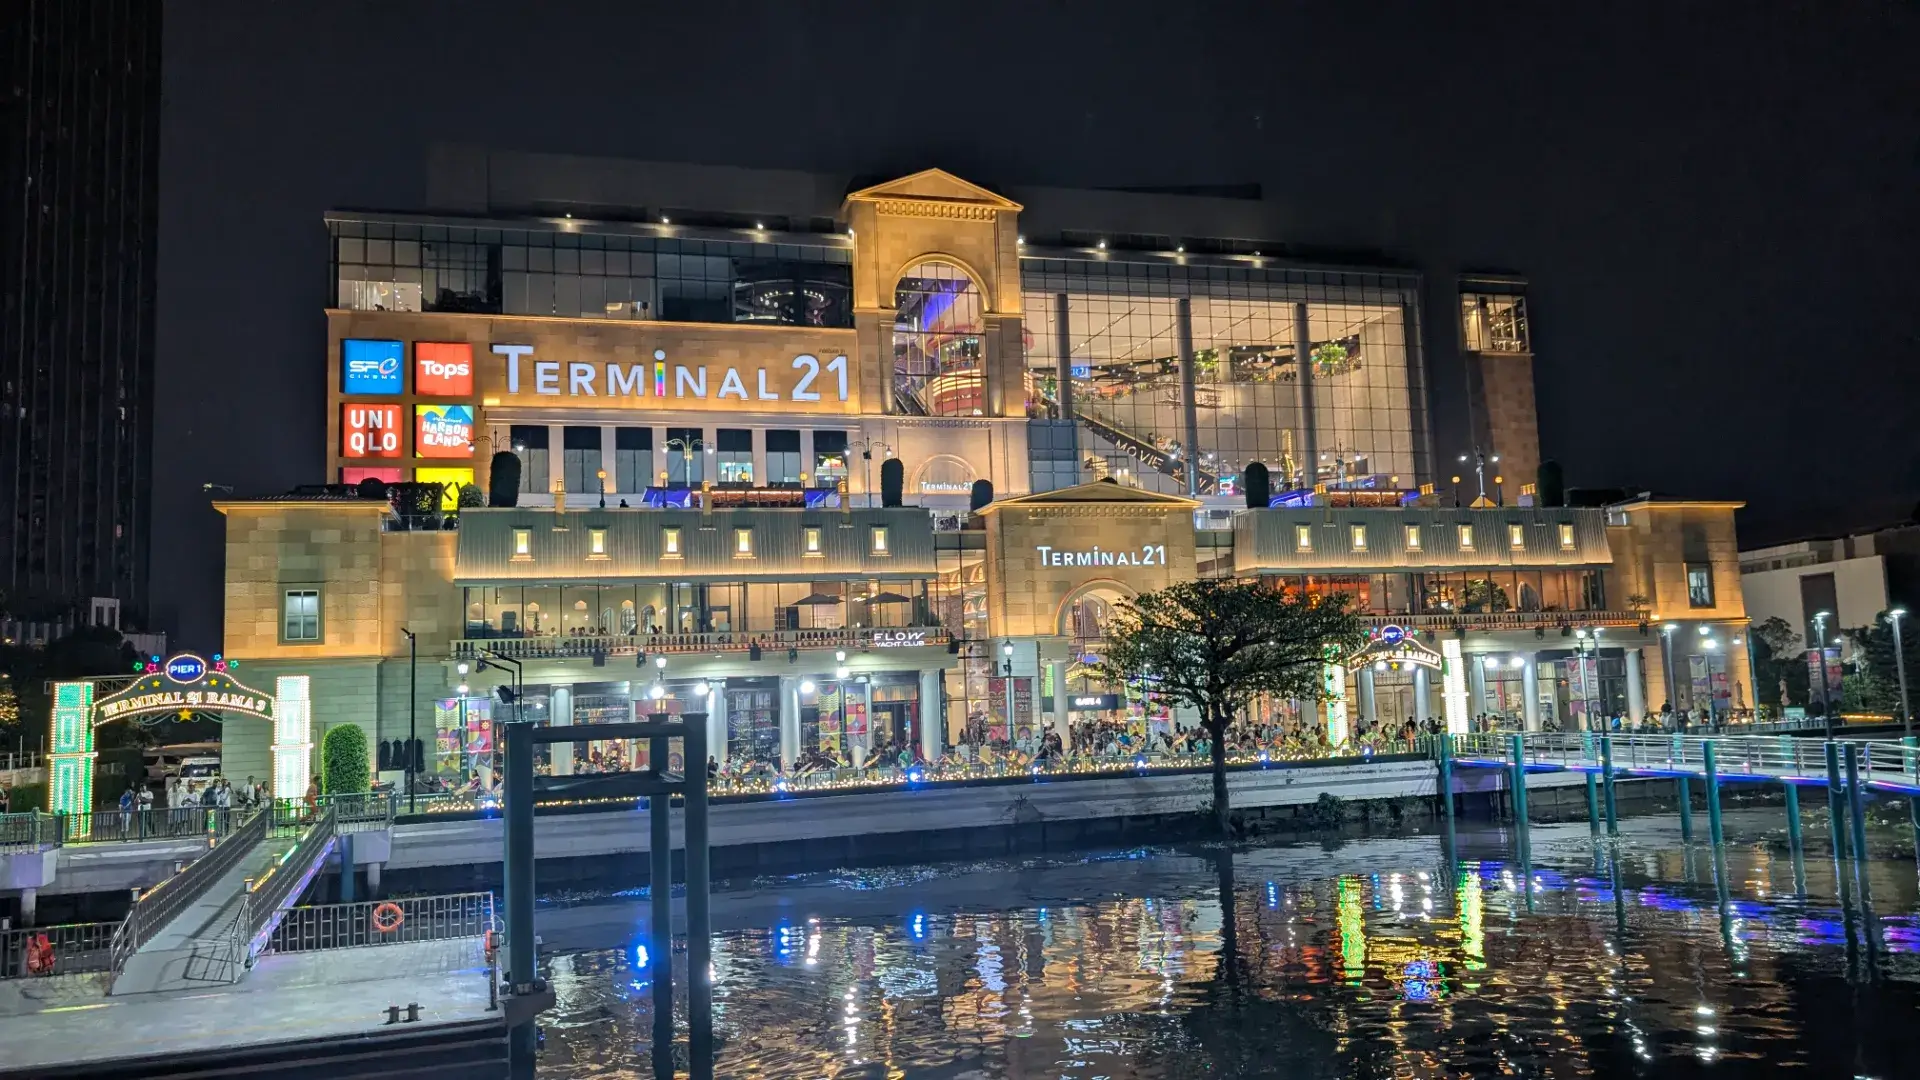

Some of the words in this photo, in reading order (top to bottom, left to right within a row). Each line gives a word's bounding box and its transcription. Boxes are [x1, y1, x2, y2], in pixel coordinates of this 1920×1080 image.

[420, 360, 469, 380] Tops
[792, 354, 848, 402] 21
[350, 409, 393, 429] UNI
[421, 420, 468, 438] HARBOR
[350, 432, 397, 455] QLO
[1115, 441, 1164, 470] MOVIE
[873, 632, 925, 641] FLOW
[170, 664, 195, 674] PIER
[196, 665, 201, 673] 1
[101, 691, 185, 718] TERMINAL
[206, 691, 254, 710] RAMA
[255, 699, 266, 712] 3
